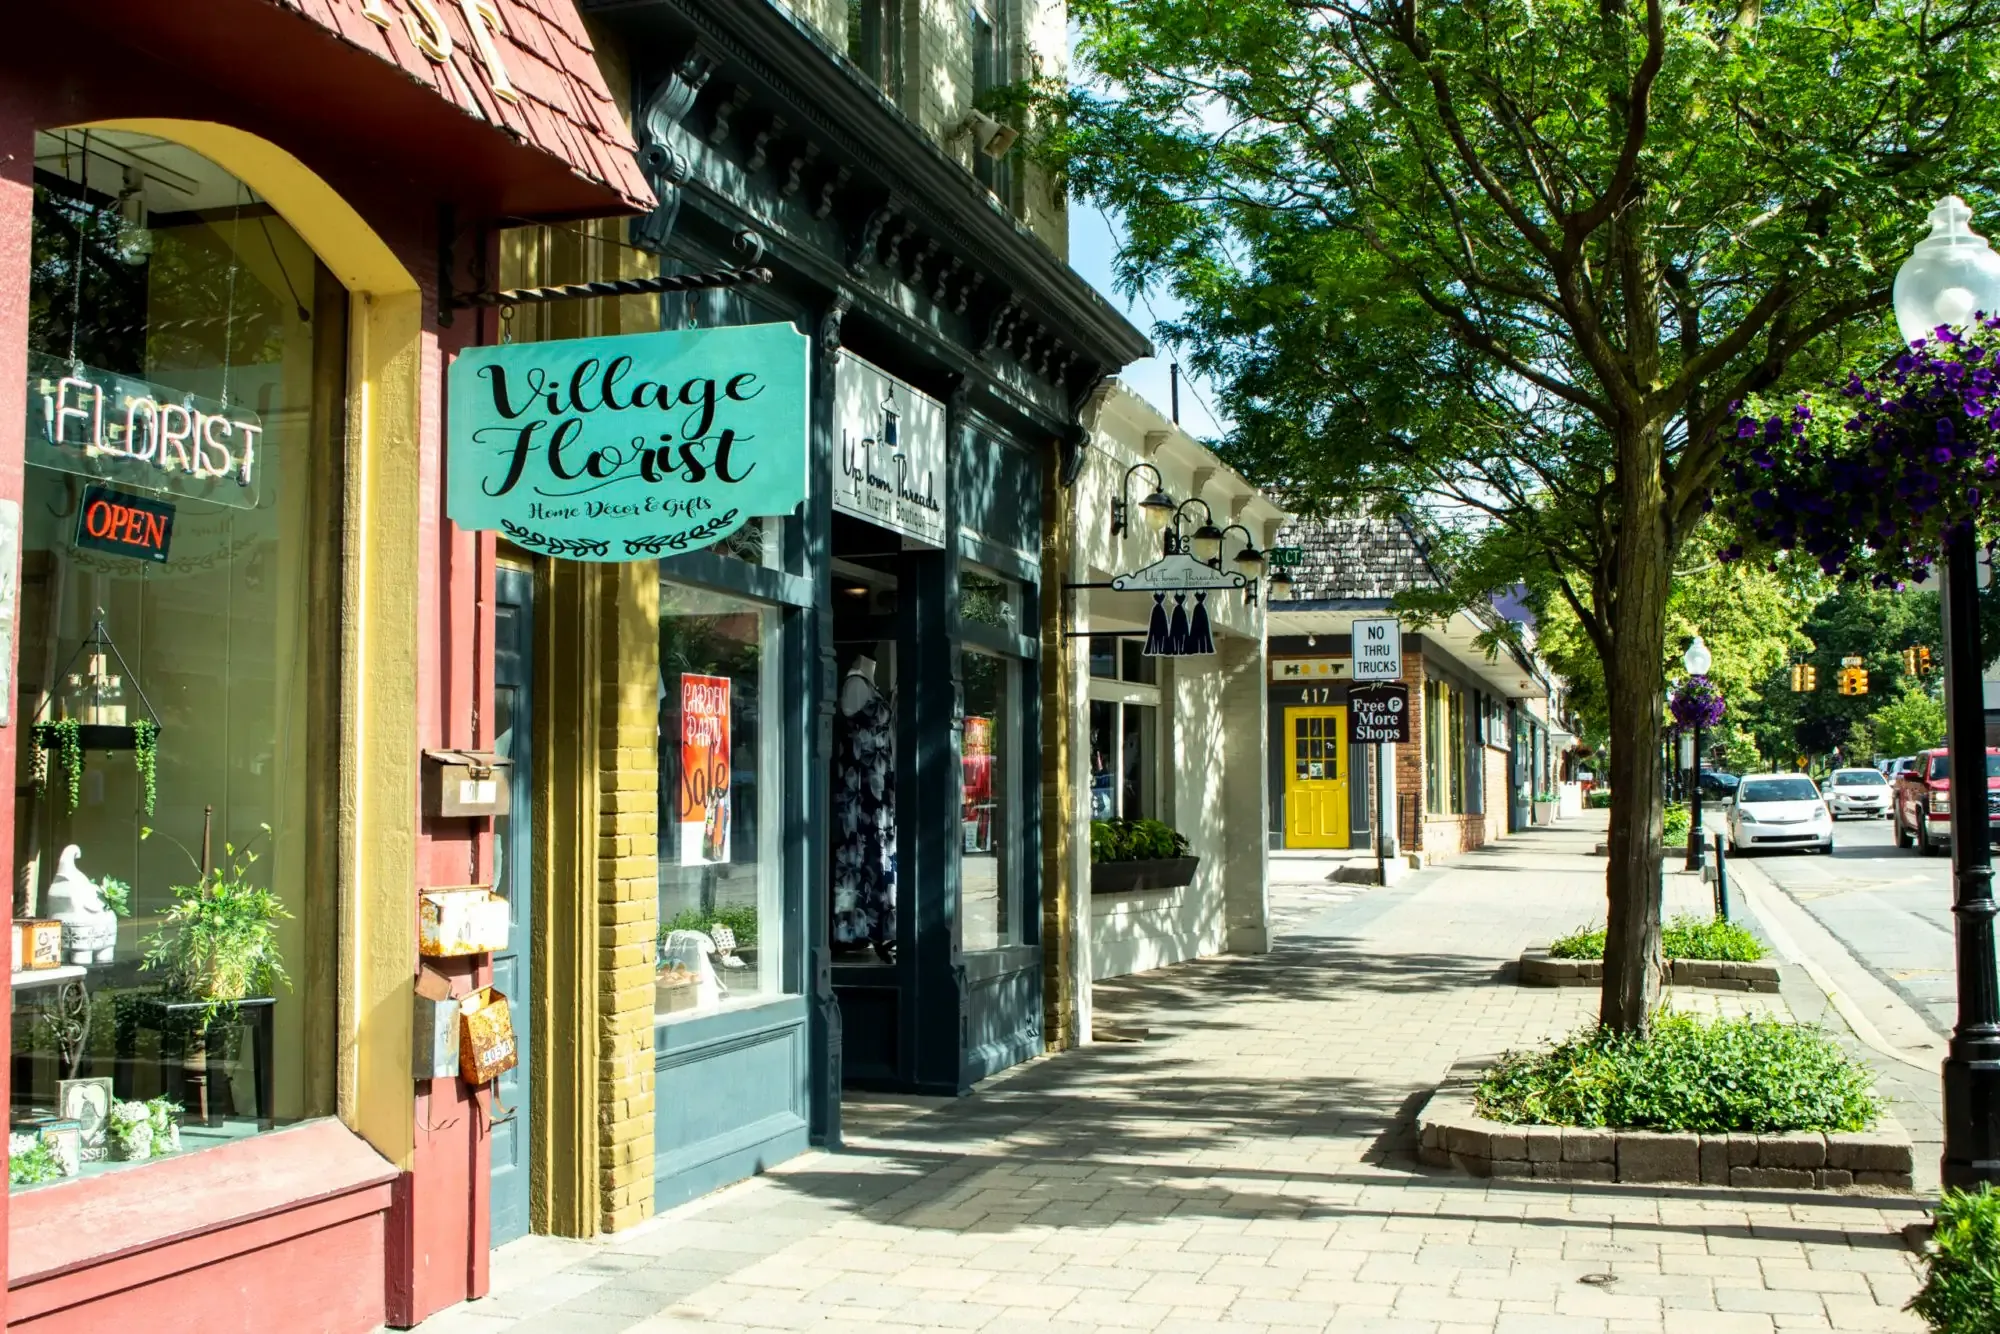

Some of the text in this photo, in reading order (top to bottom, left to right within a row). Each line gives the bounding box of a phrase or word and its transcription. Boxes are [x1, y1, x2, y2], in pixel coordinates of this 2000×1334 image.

[477, 356, 766, 440] Village
[56, 377, 262, 485] FLORIST
[472, 418, 756, 497] Florist
[843, 428, 939, 512] Up Town Threads
[529, 502, 580, 520] Home
[645, 496, 658, 513] &
[662, 495, 712, 518] Gifts
[87, 500, 168, 549] OPEN
[1368, 626, 1384, 640] NO
[1364, 645, 1390, 656] THRU
[1358, 661, 1397, 673] TRUCKS
[683, 682, 727, 717] GARDEN
[1301, 688, 1329, 703] 417
[1353, 699, 1385, 712] Free
[1359, 712, 1398, 725] More
[1356, 726, 1400, 742] Shops
[682, 740, 729, 817] Sale
